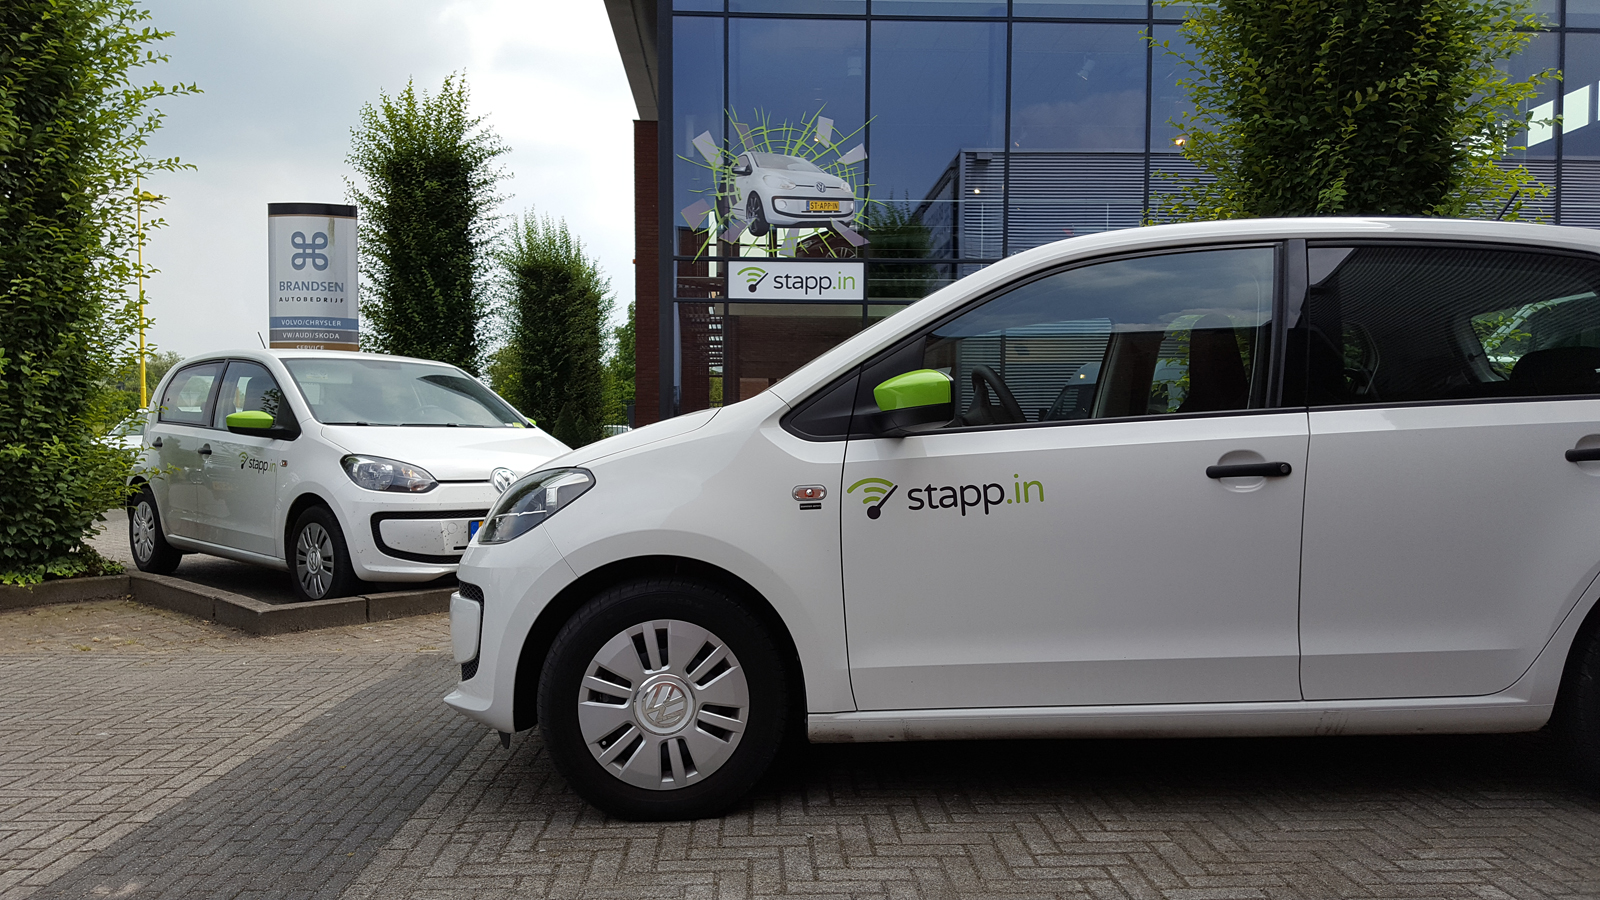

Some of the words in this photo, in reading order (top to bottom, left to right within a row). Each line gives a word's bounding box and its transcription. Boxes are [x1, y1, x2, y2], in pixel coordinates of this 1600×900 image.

[279, 281, 344, 293] BRANDSEN
[773, 271, 856, 295] stapp.in
[281, 319, 342, 327] VOLVO/CHRYSLER
[248, 458, 276, 474] stapp.in
[907, 473, 1045, 516] stapp.in
